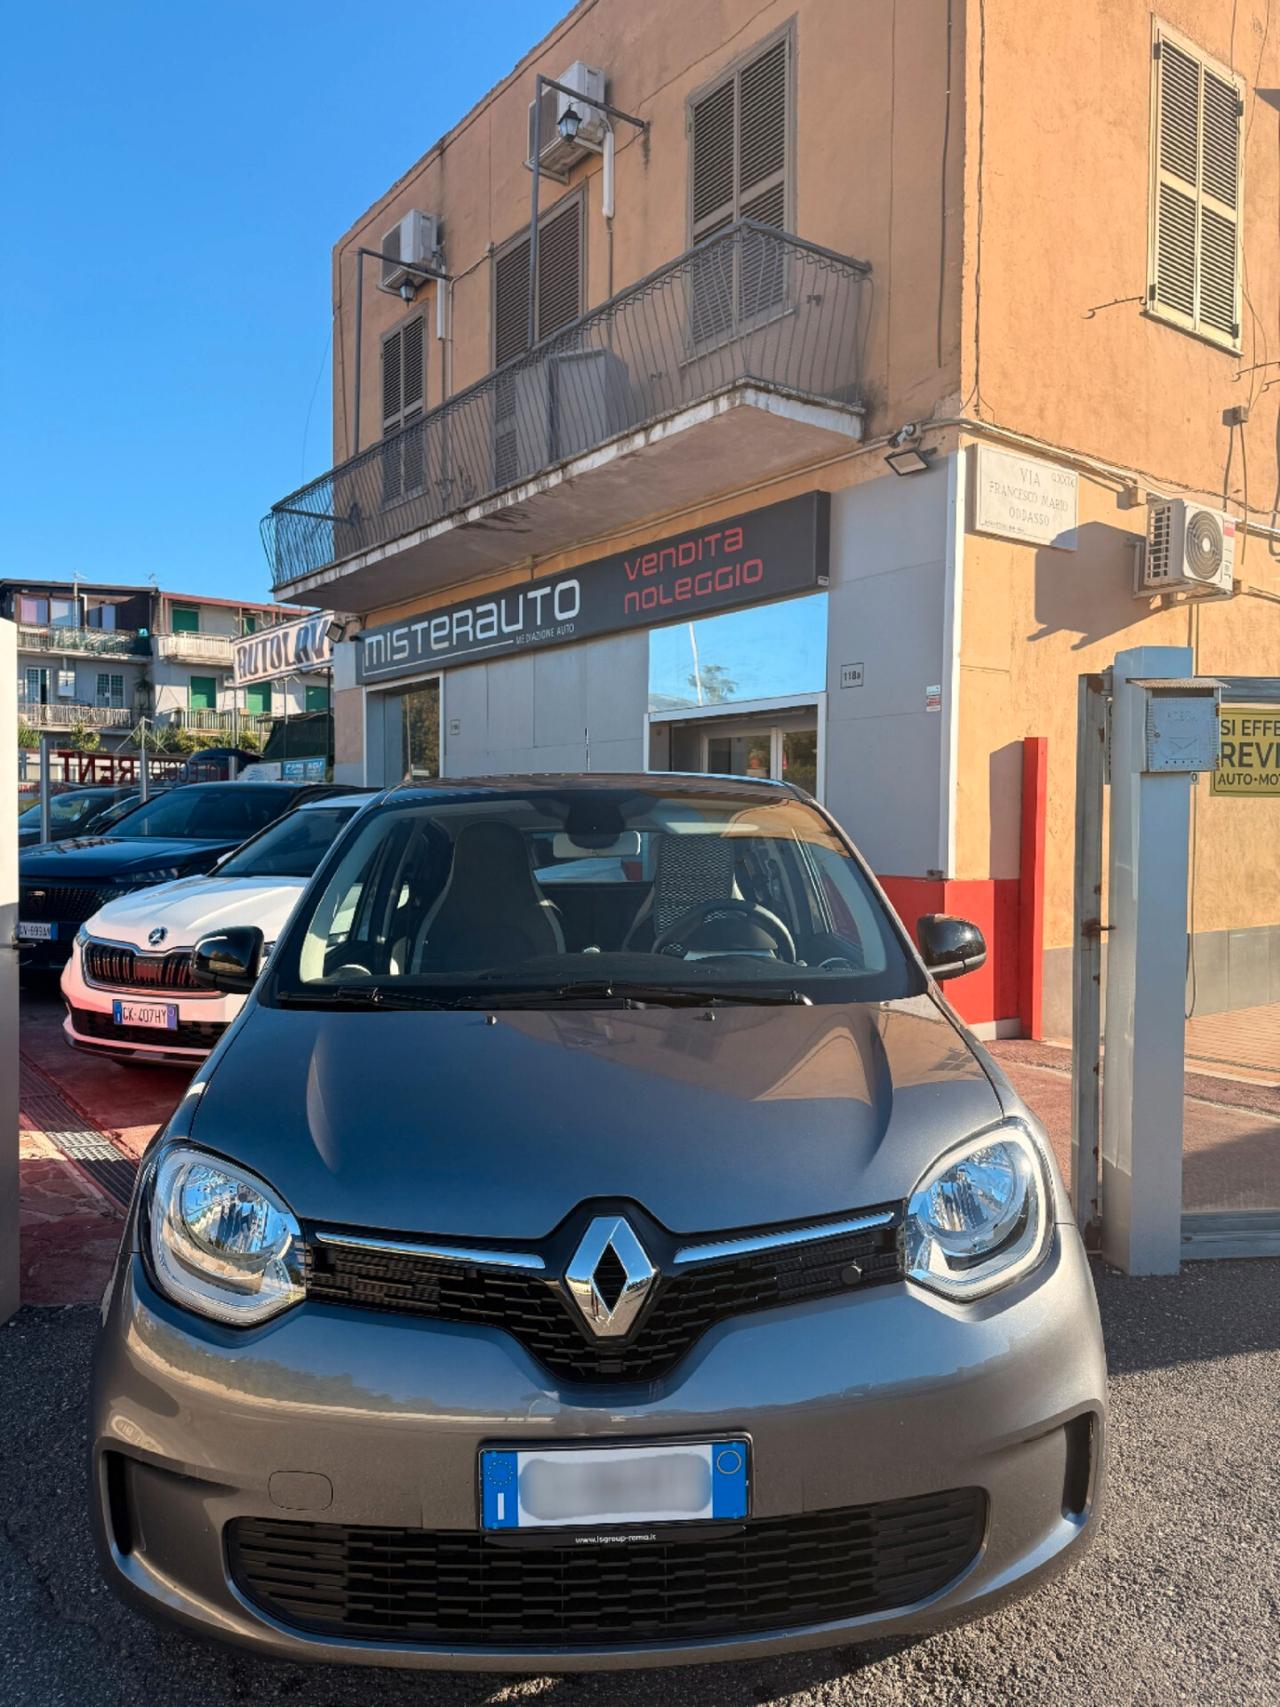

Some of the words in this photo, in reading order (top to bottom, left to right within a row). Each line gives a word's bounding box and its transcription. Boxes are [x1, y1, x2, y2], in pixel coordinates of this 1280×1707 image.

[1020, 467, 1040, 487] VIA
[989, 480, 1038, 503] FRANCESCO
[1042, 495, 1069, 512] MARIO
[1009, 506, 1049, 526] ODDASSO
[556, 623, 575, 635] AUTO
[1220, 719, 1236, 736] SI
